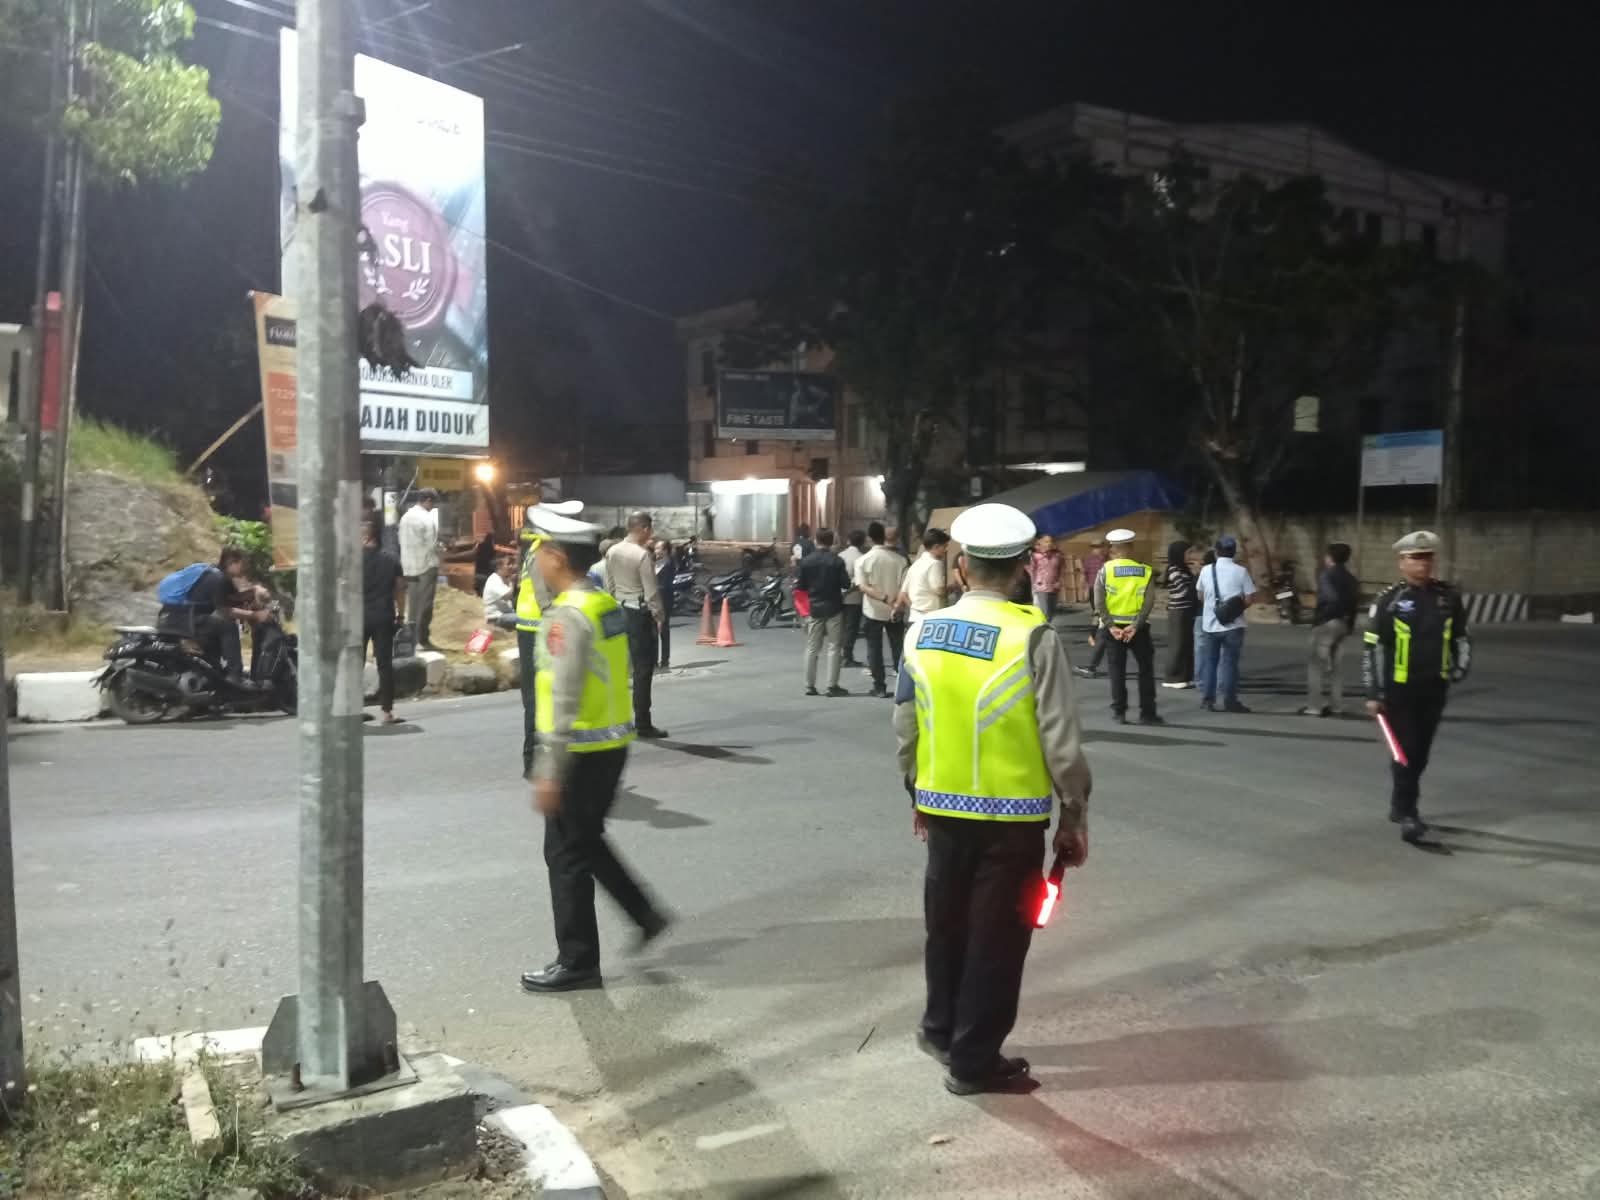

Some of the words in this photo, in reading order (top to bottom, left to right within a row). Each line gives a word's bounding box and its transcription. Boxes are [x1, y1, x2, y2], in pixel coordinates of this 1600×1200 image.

[375, 233, 432, 275] SLI
[360, 404, 409, 432] AJAH
[416, 408, 476, 436] DUDUK
[918, 623, 997, 654] POLISI
